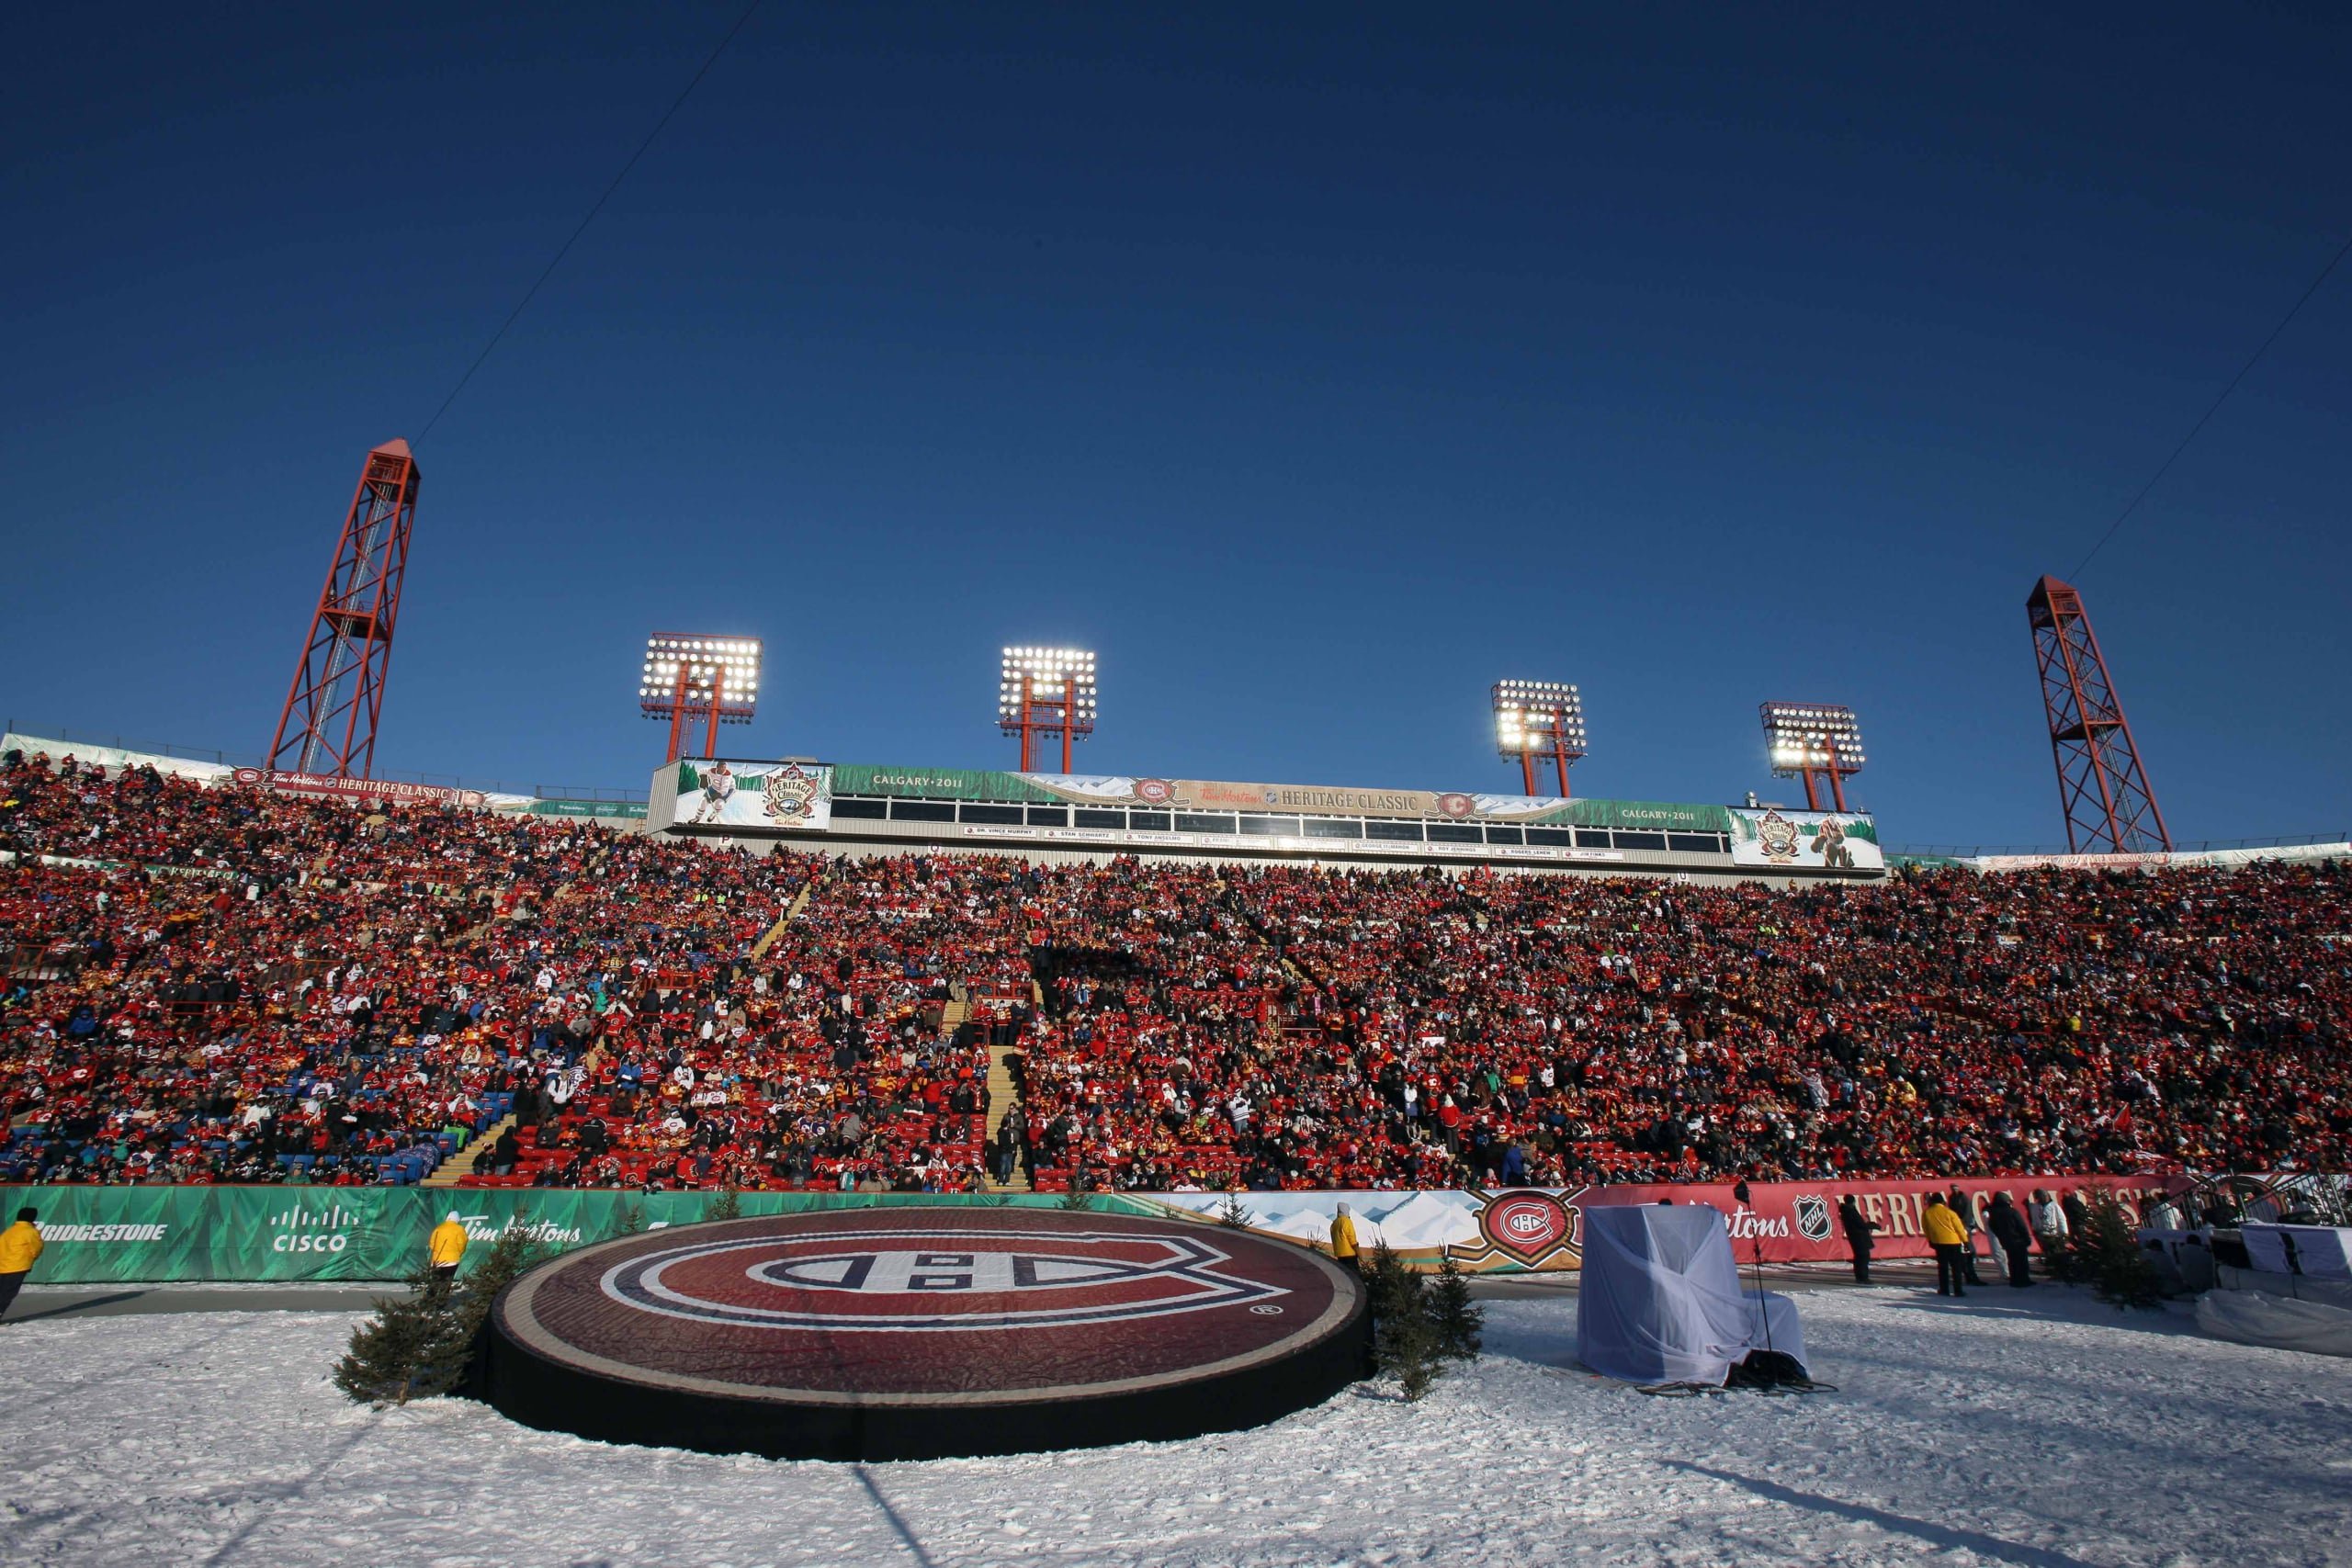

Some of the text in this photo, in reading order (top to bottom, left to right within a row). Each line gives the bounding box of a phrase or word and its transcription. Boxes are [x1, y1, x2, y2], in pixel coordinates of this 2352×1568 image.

[272, 773, 448, 799] Tim Hortons HERITAGE CLASSIC
[772, 781, 811, 795] HERITAGE
[873, 774, 963, 788] CALGARY 2011
[1200, 787, 1418, 811] Tim Hortons HERITAGE CLASSIC
[1623, 809, 1694, 821] CALGARY 2011
[722, 834, 729, 844] P
[460, 1214, 581, 1242] Tim Hrtons
[1724, 1204, 1790, 1238] rtons
[274, 1235, 347, 1252] CISCO
